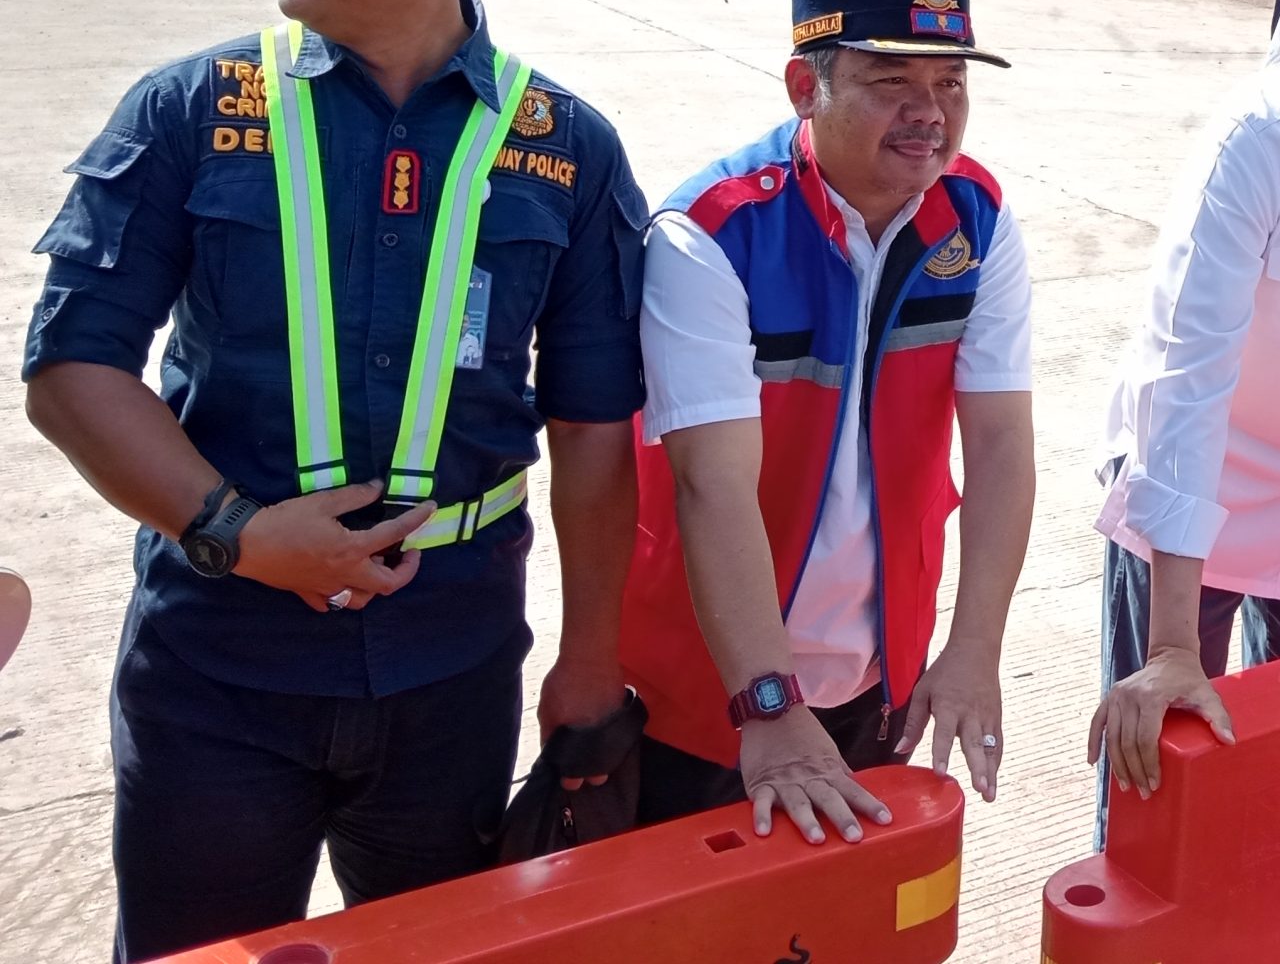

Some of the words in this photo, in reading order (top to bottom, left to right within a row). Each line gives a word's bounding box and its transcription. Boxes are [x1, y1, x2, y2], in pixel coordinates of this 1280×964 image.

[217, 96, 269, 118] CRI
[213, 127, 273, 154] DE
[526, 152, 576, 188] POLICE
